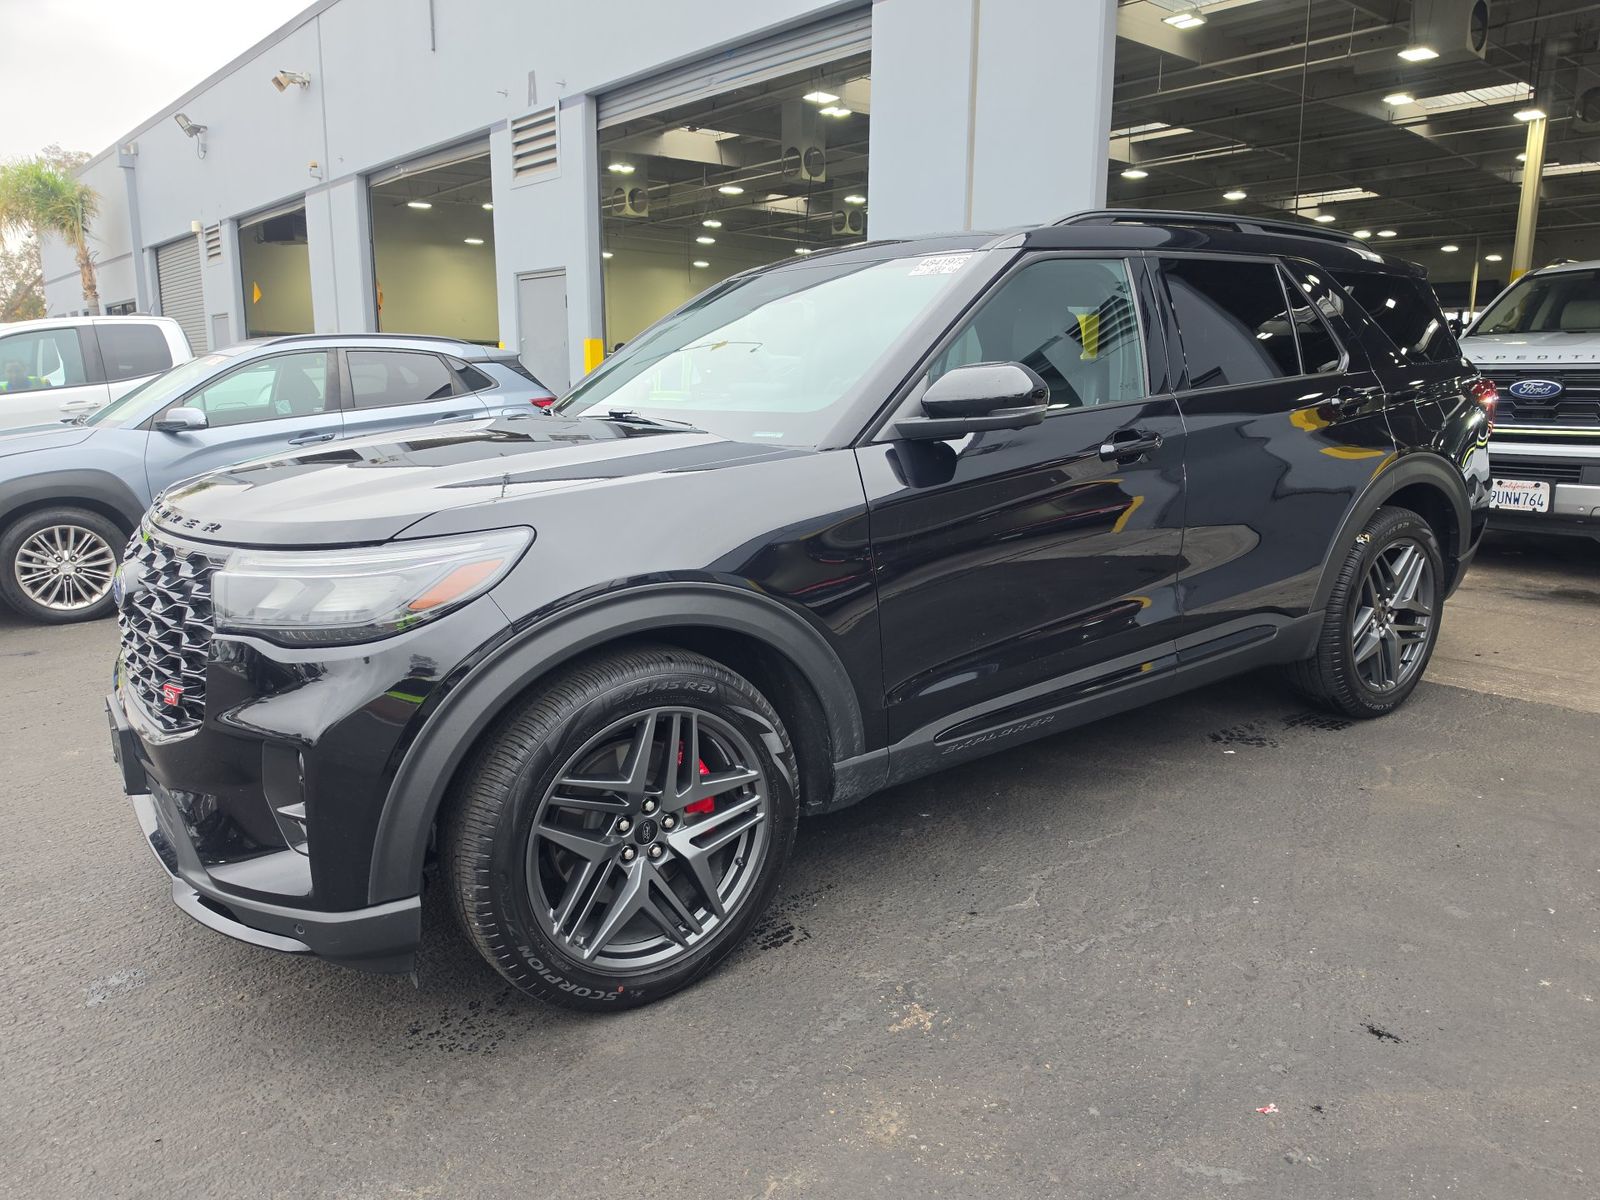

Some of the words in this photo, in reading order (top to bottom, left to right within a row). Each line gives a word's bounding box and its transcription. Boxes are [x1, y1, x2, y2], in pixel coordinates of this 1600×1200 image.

[1490, 490, 1544, 508] 9UNW764
[163, 683, 184, 706] ST
[516, 945, 623, 1001] SCORPION
